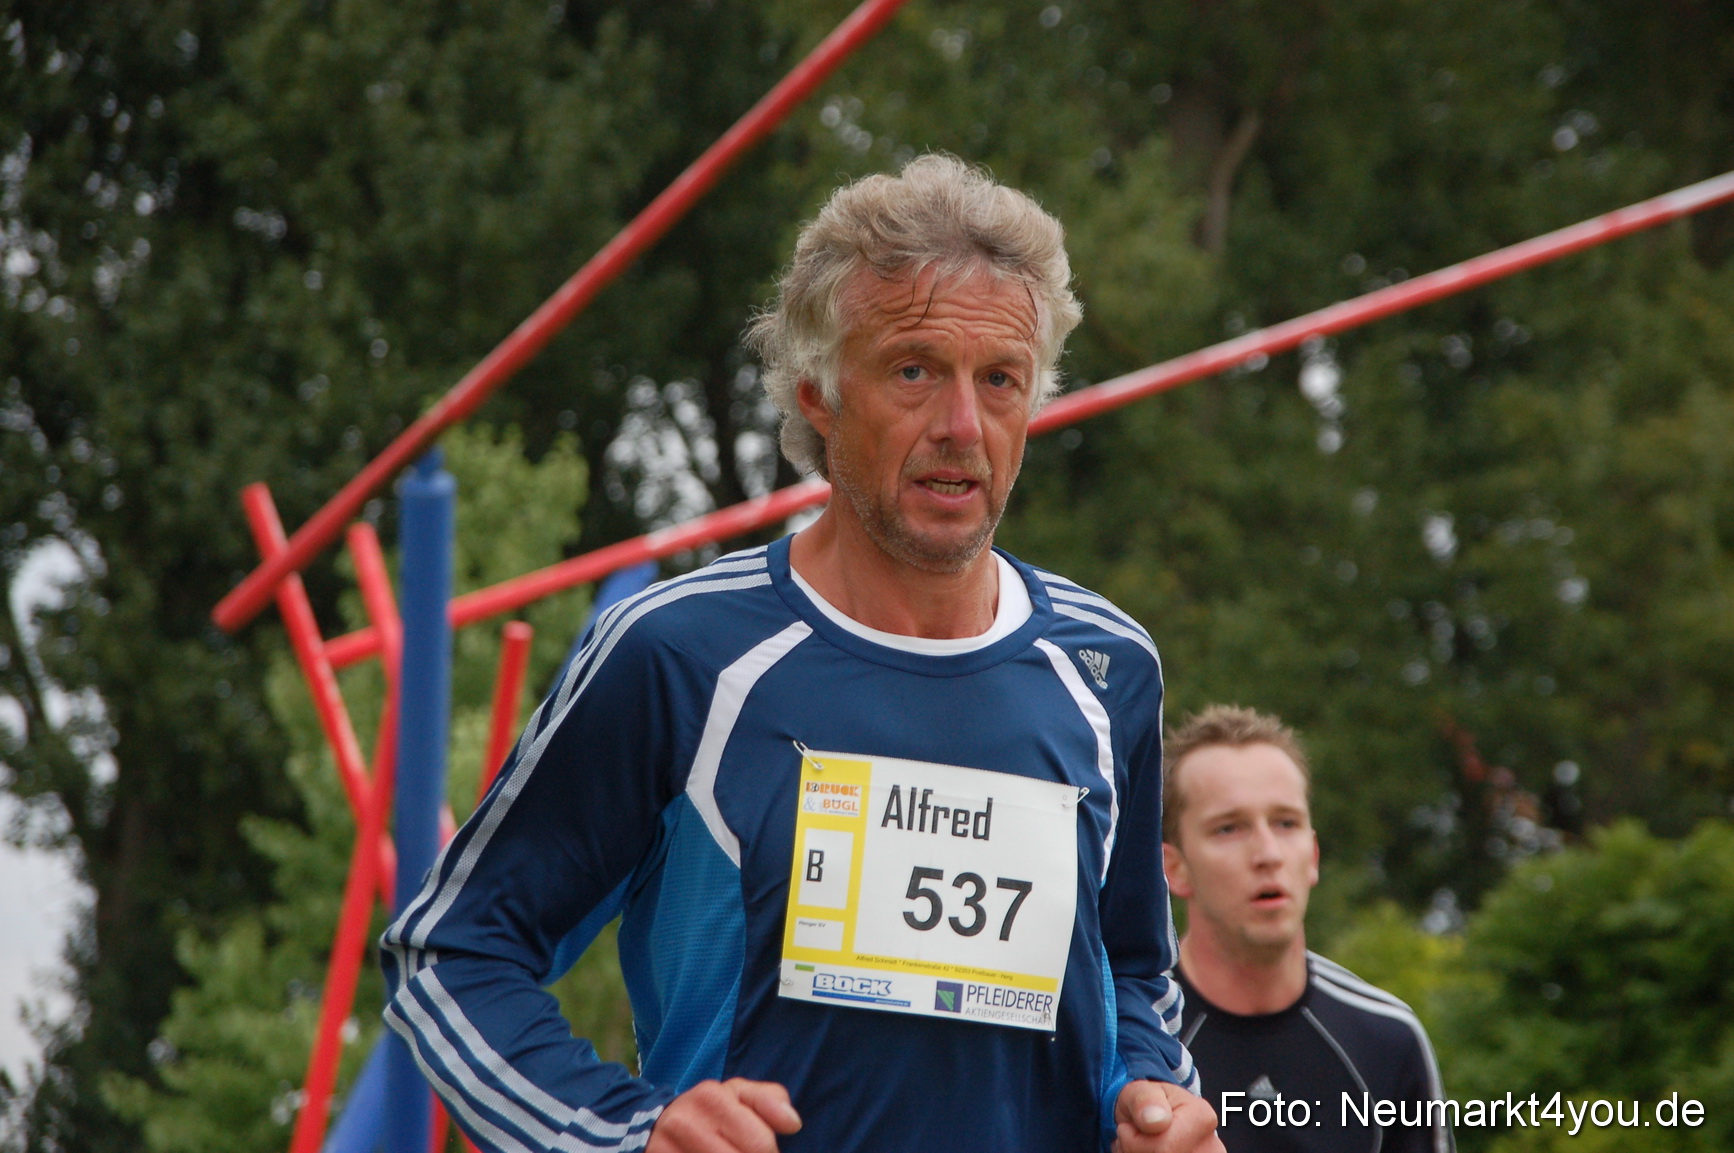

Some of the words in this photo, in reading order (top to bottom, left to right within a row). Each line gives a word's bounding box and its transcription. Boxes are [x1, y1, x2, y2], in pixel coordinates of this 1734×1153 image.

[1079, 650, 1108, 689] adidas
[881, 784, 993, 841] Alfred
[806, 849, 824, 882] B
[902, 866, 1033, 942] 537
[813, 974, 892, 996] BOCK
[967, 984, 1053, 1013] PFLEIDERER
